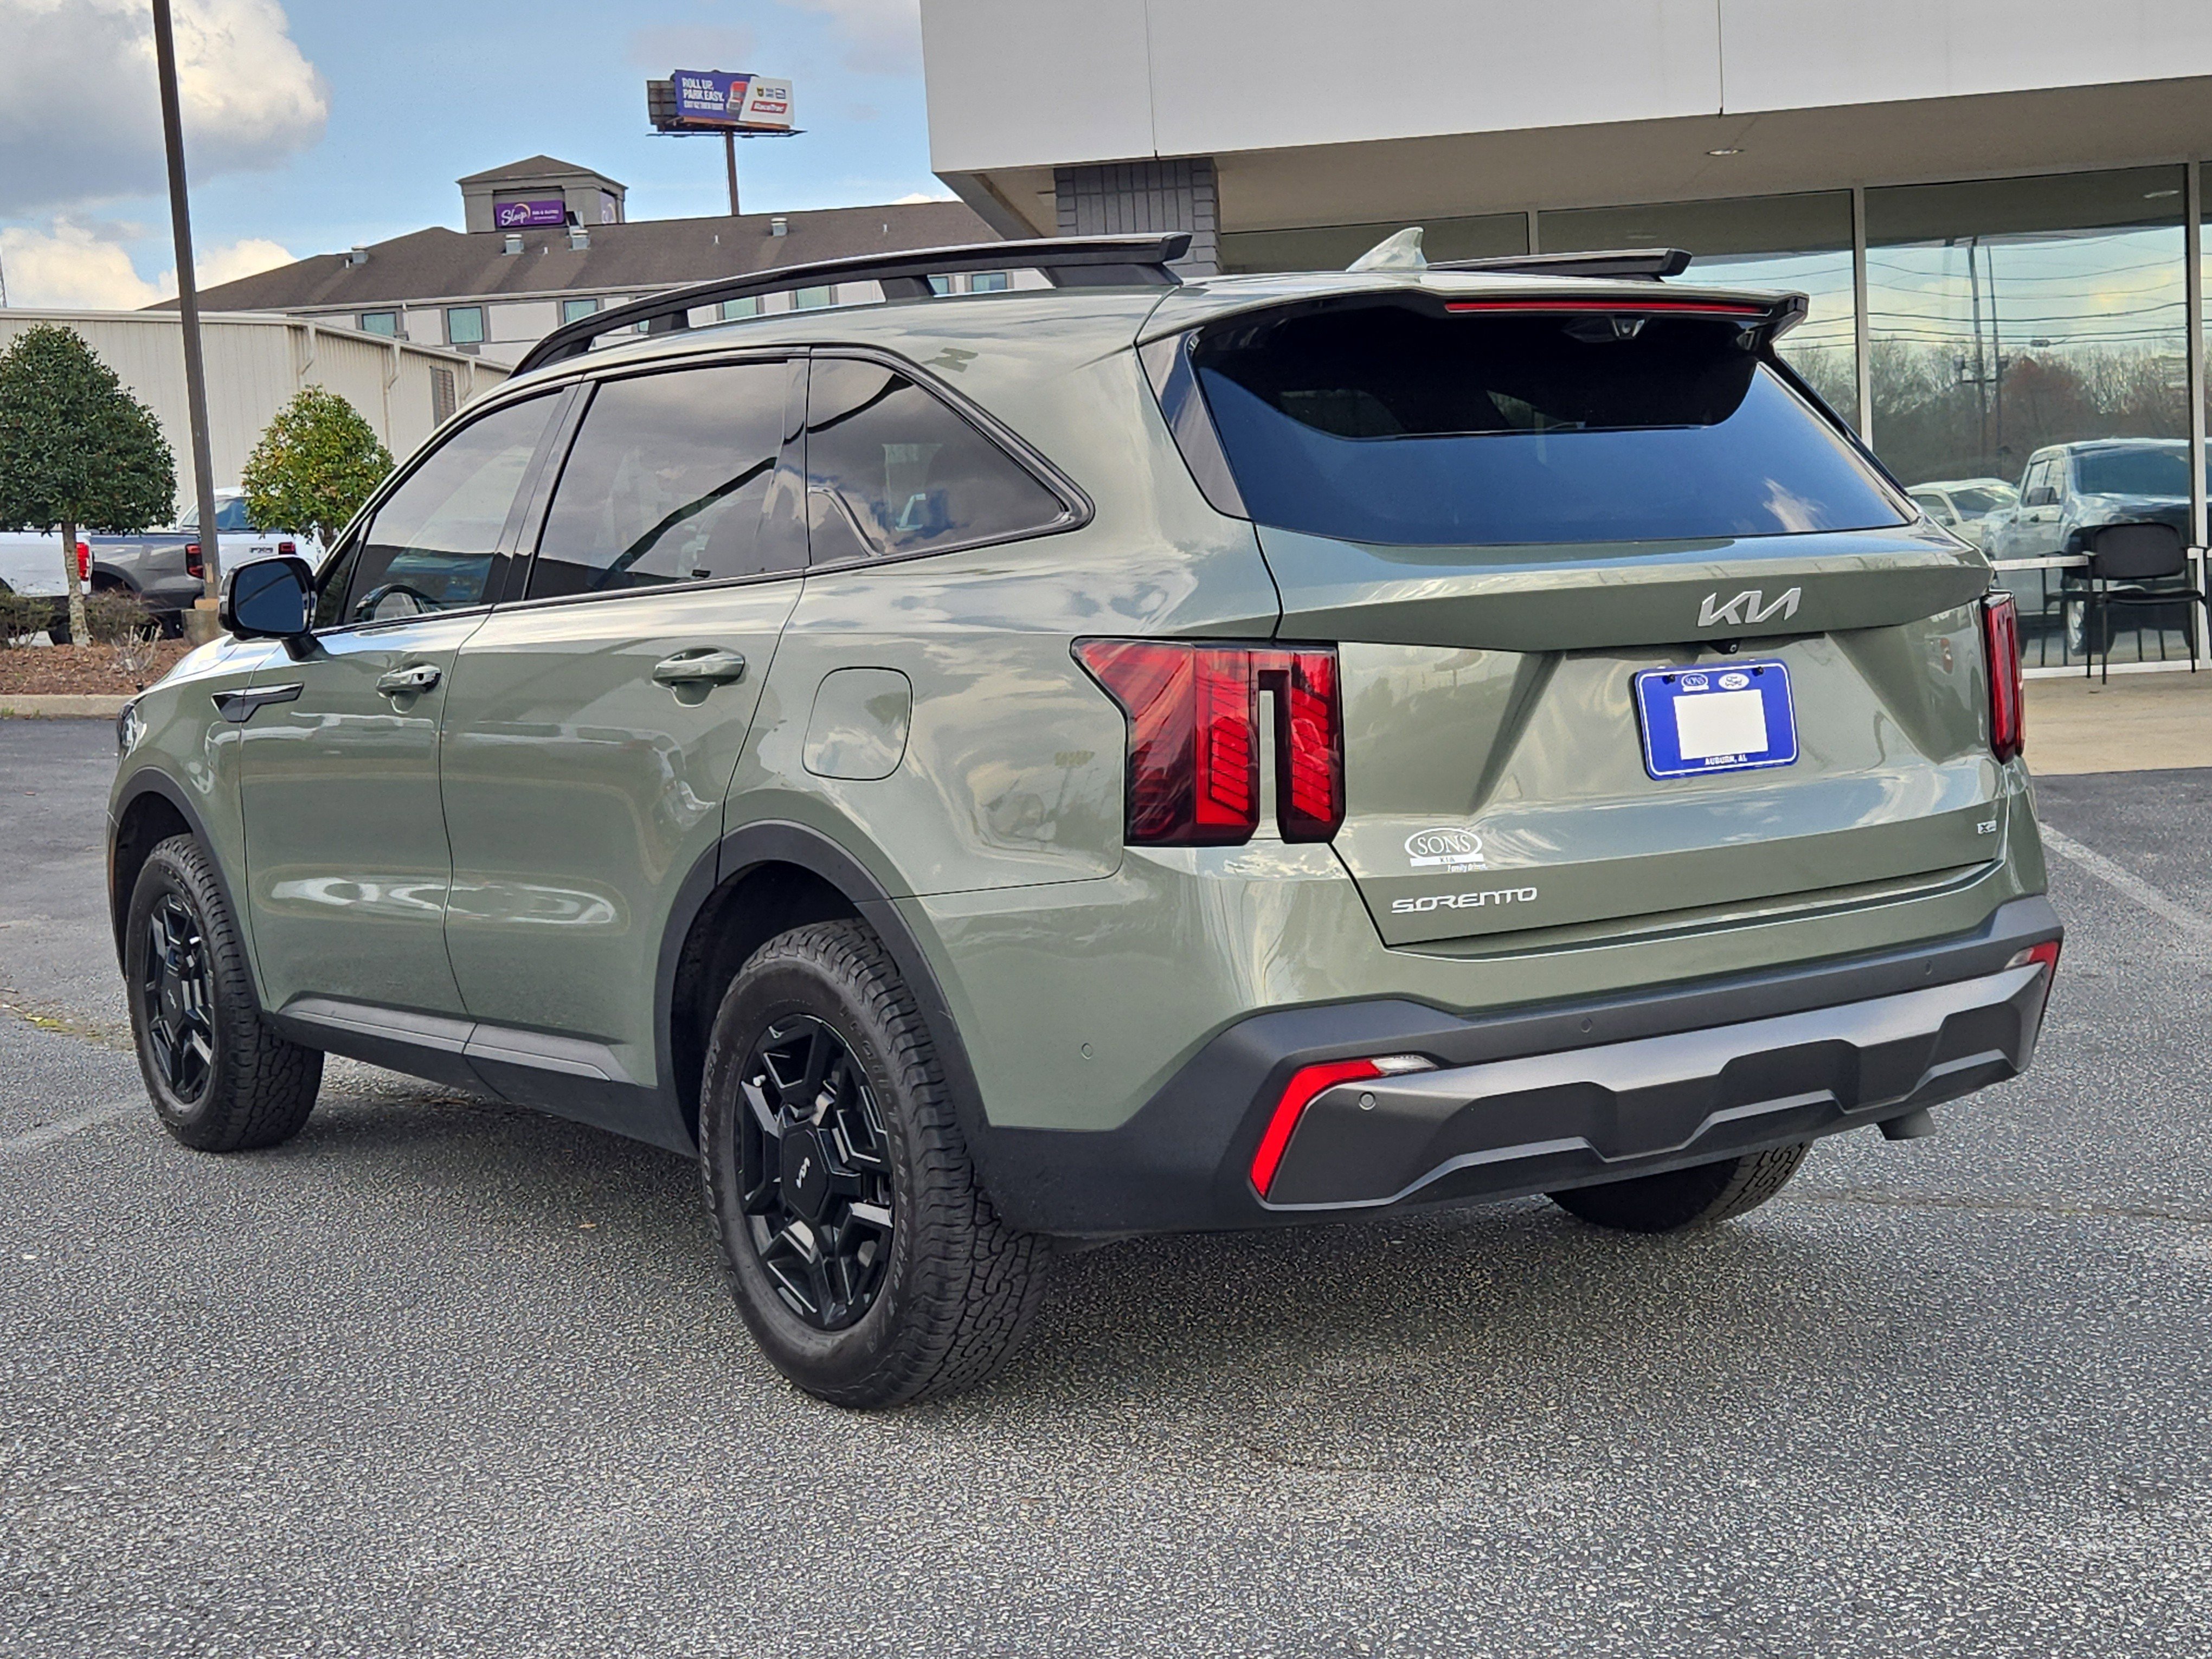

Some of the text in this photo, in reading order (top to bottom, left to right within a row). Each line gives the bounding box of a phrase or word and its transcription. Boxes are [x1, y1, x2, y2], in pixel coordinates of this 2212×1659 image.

[681, 78, 702, 89] ROLL
[501, 209, 527, 226] Sleep
[1697, 587, 1801, 627] KIA
[1738, 754, 1748, 762] AL
[1417, 834, 1471, 855] SONS
[1391, 886, 1538, 914] SORENTO
